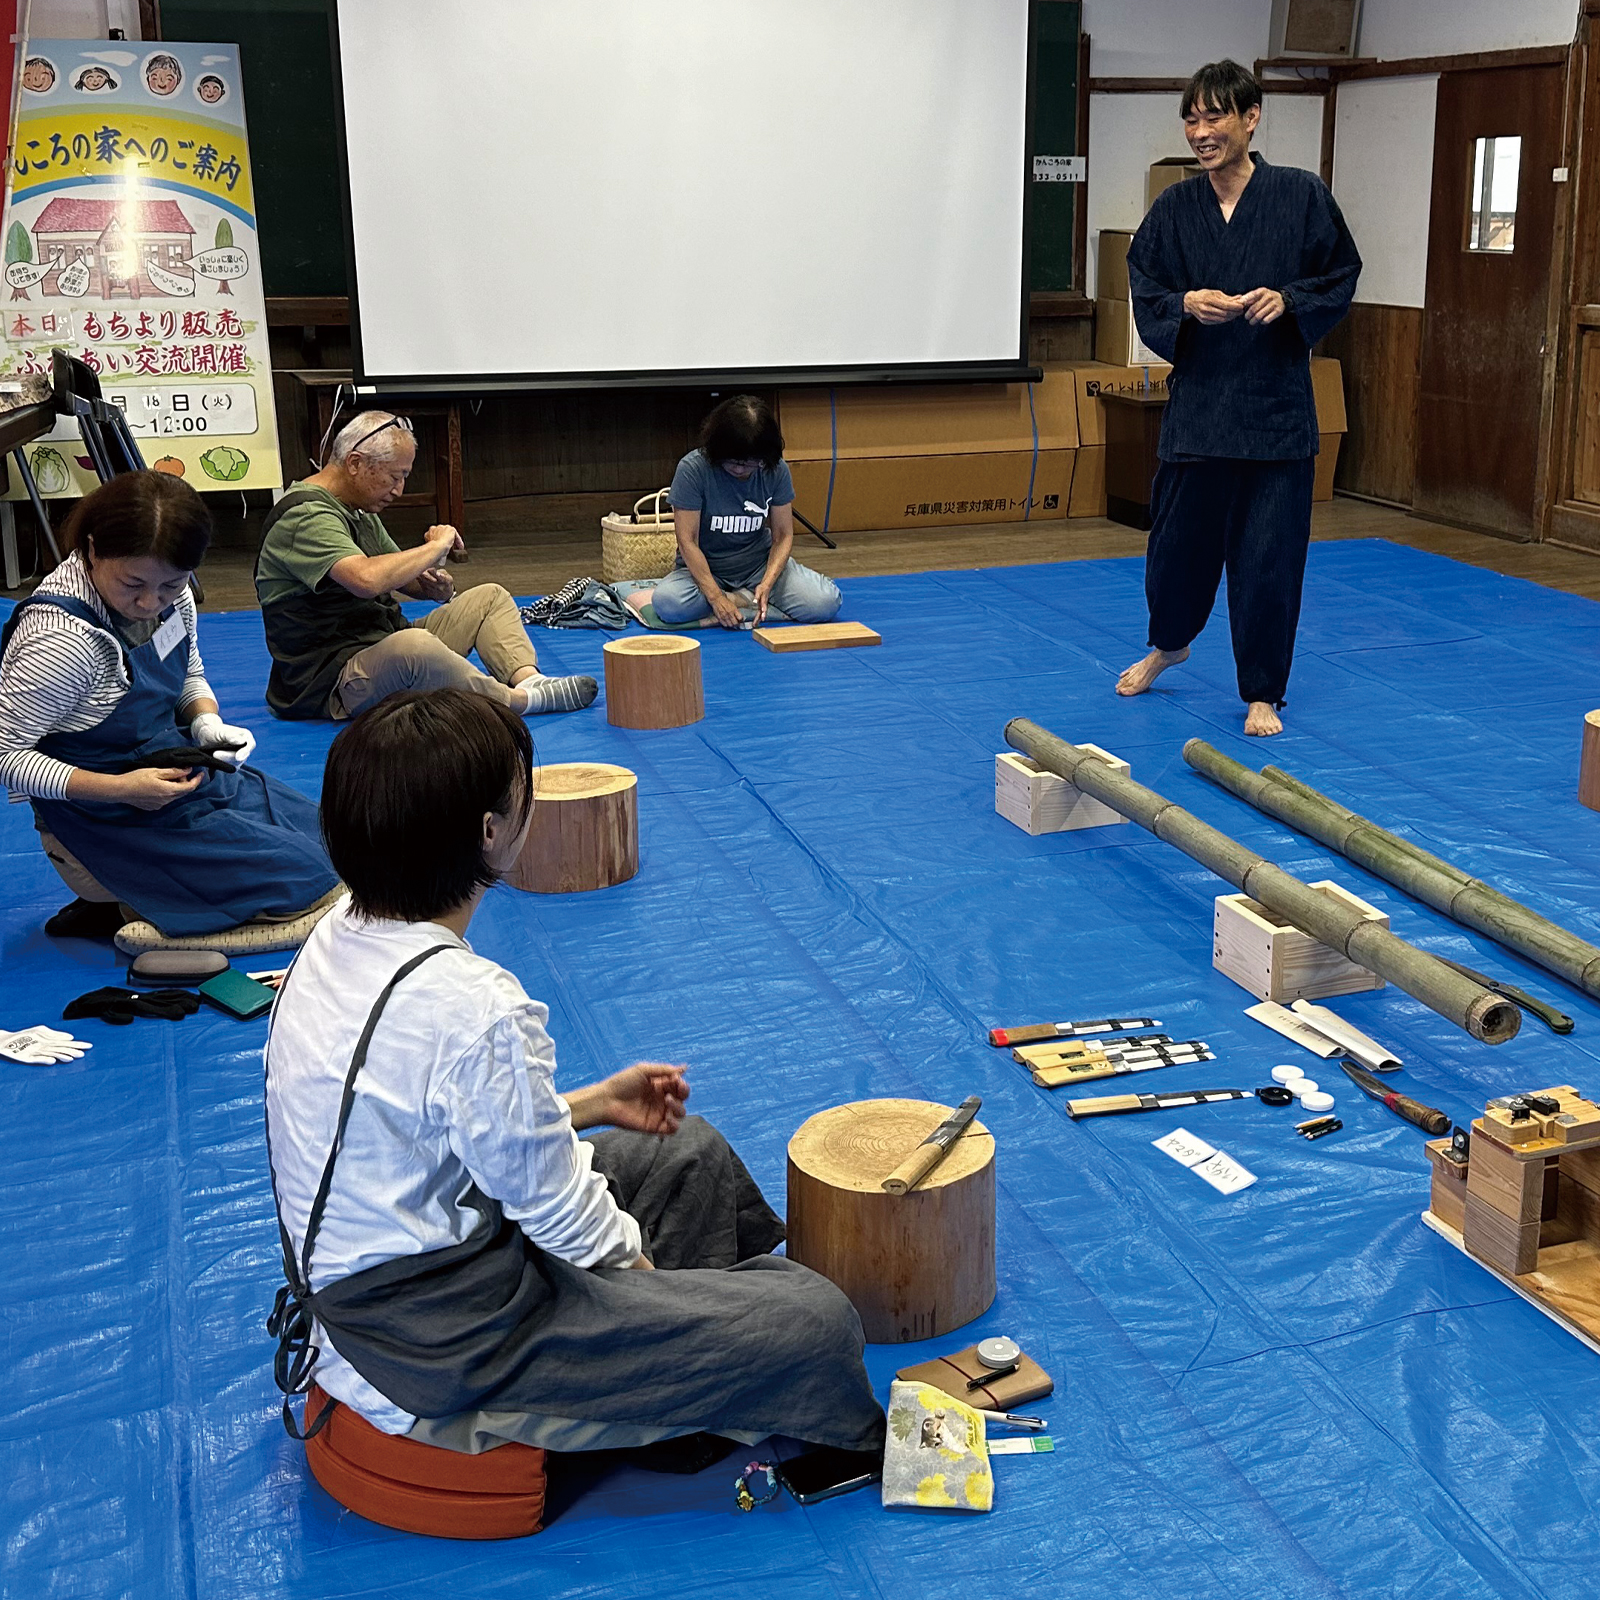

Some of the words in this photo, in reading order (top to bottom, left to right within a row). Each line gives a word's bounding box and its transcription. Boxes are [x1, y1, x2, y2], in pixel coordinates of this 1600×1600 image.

[199, 254, 244, 263] いっしょに楽しく
[11, 313, 56, 337] 本日
[83, 308, 244, 340] もちより販売
[172, 394, 189, 411] 日
[904, 498, 1040, 517] 兵庫県災害対策用トイレ
[710, 515, 763, 533] PUMA
